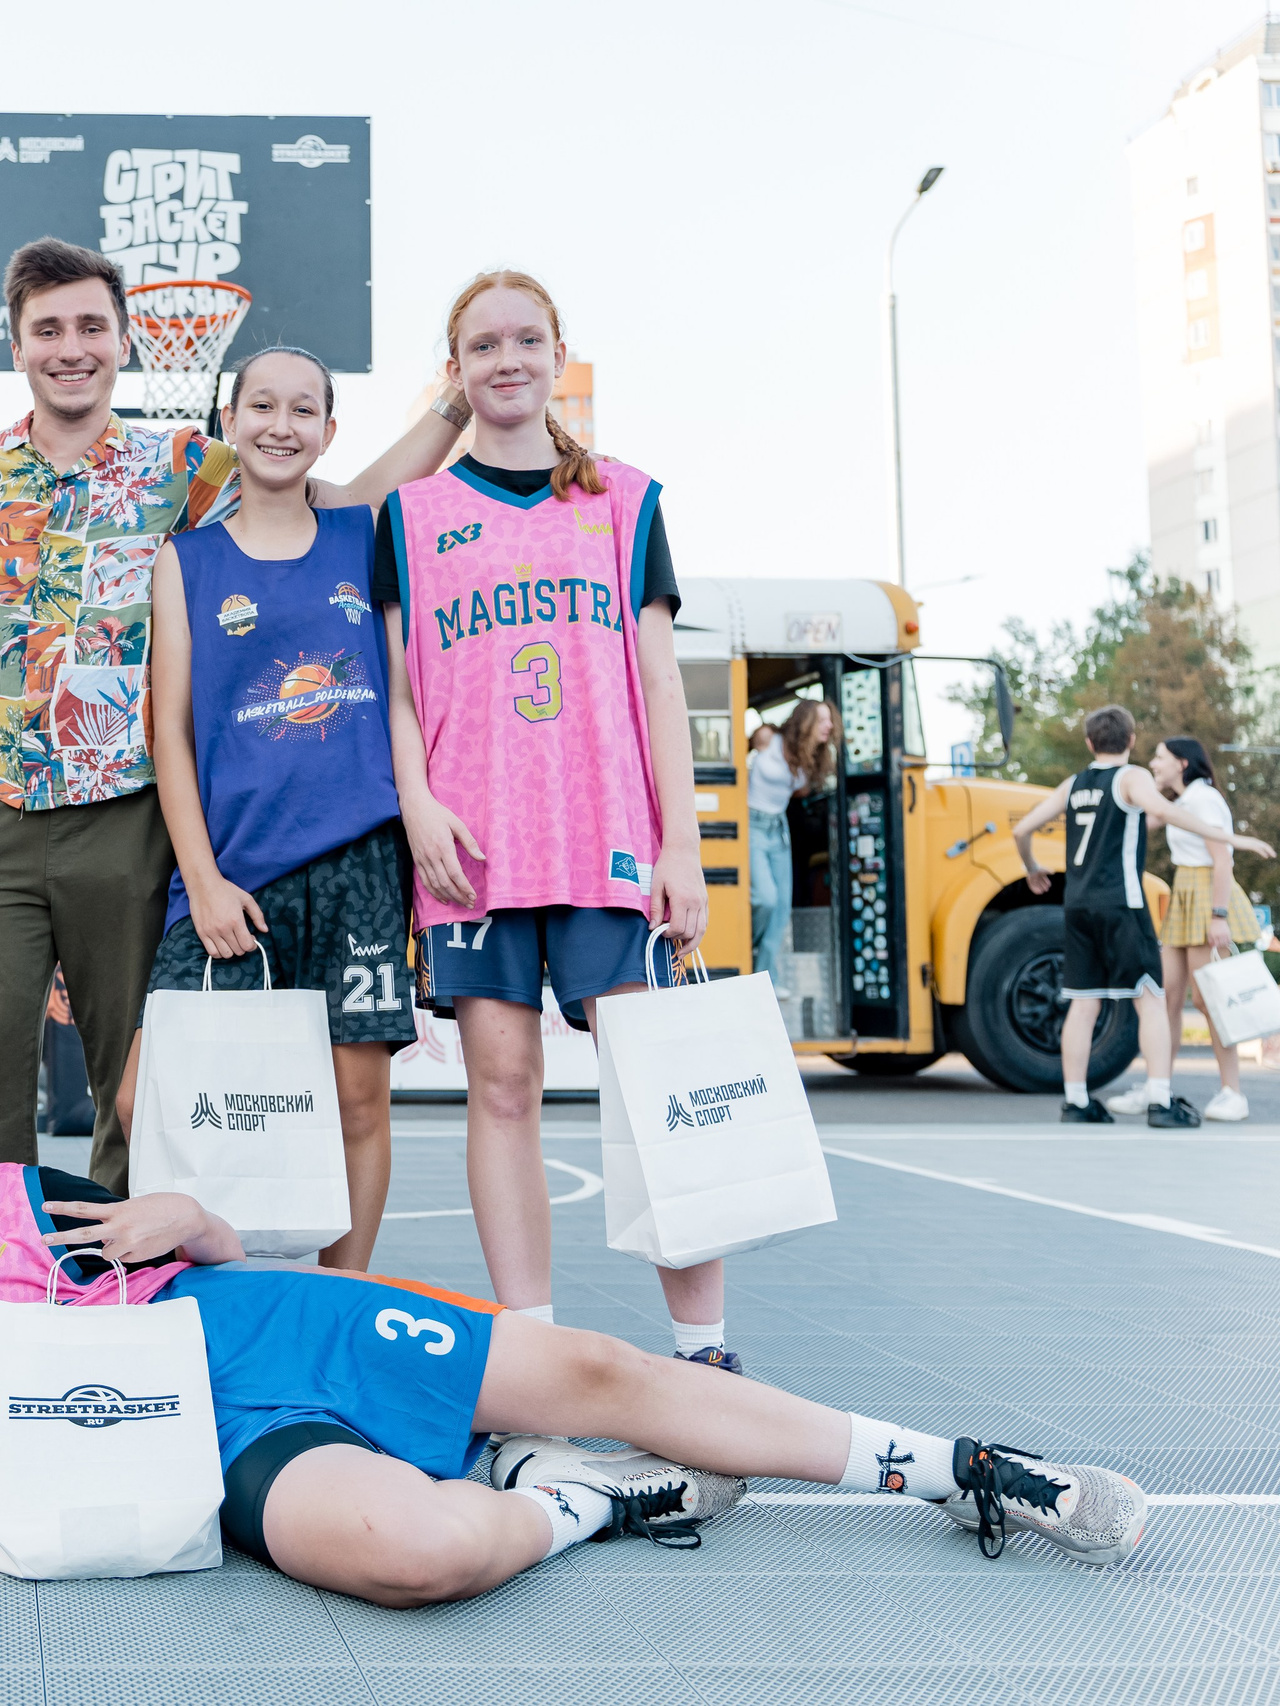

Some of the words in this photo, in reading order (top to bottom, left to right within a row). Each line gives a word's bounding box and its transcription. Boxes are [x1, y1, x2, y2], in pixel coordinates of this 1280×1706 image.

[103, 148, 241, 209] СТРИТ
[100, 197, 249, 255] БАСКЕТ
[103, 241, 241, 286] ТУР
[511, 641, 563, 723] 3
[1074, 812, 1096, 866] 7
[447, 917, 493, 950] 17
[343, 963, 402, 1012] 21
[224, 1090, 314, 1112] МОСКОВСКИЙ
[688, 1073, 768, 1107] МОСКОВСКИЙ
[227, 1112, 266, 1132] СПОРТ
[695, 1104, 733, 1127] СПОРТ
[375, 1308, 455, 1355] 3
[8, 1401, 180, 1417] STREETBASKET
